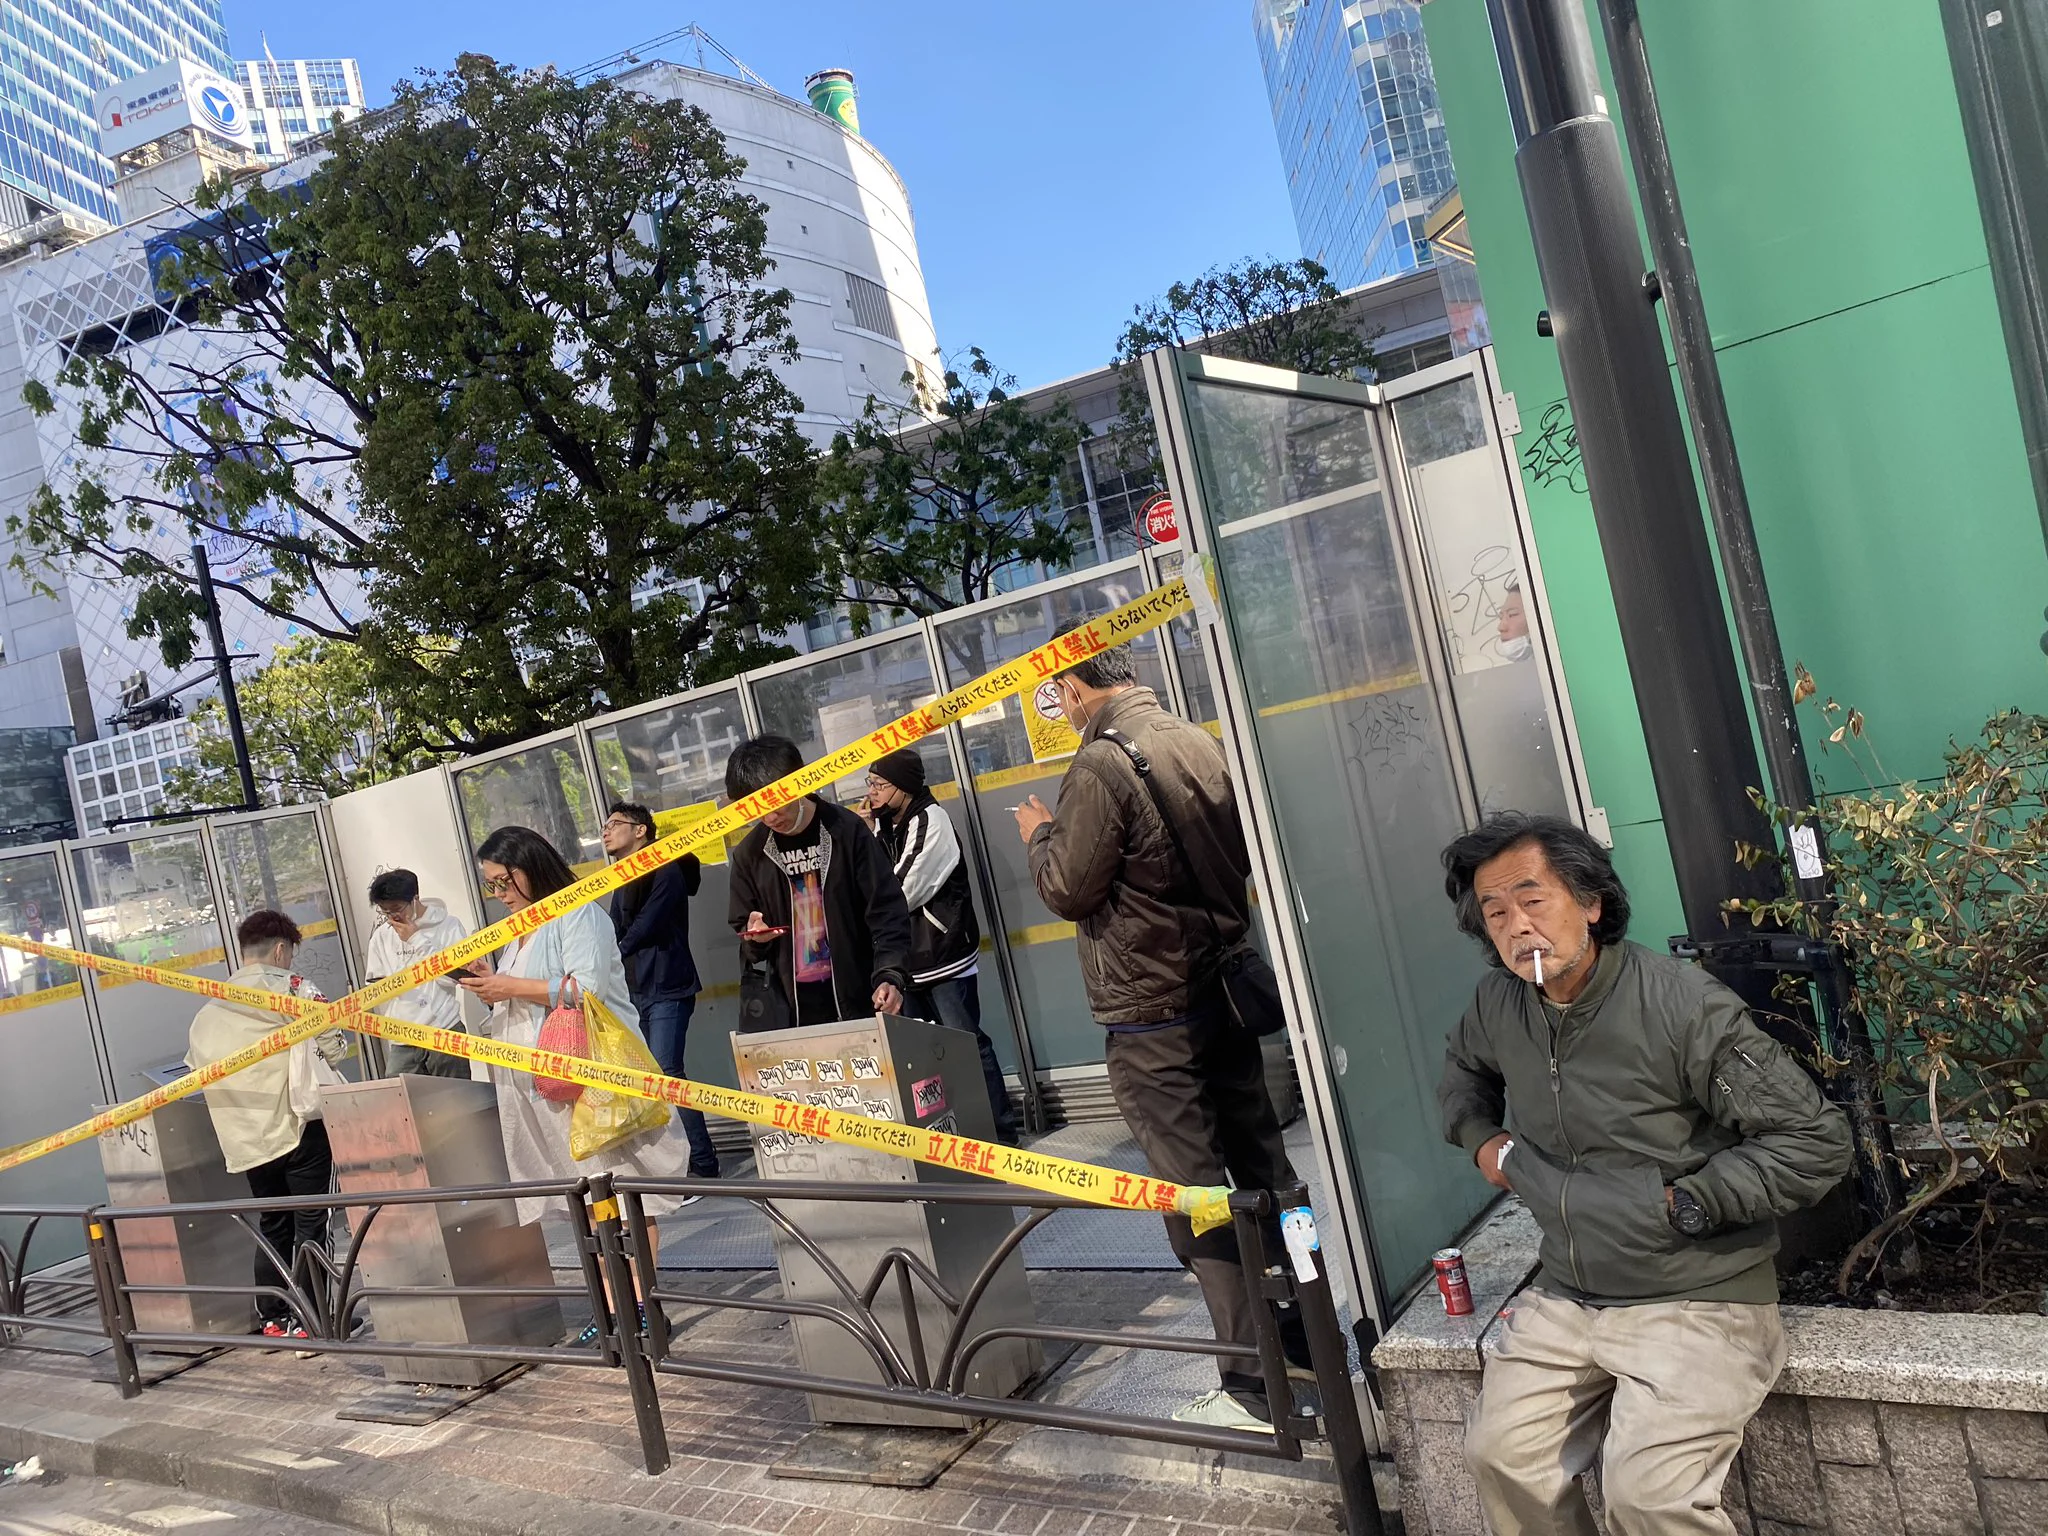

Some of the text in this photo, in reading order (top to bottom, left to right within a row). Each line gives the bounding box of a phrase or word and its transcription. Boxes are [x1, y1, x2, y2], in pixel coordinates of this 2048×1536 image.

[124, 93, 183, 124] TOKYU
[259, 1029, 289, 1056] 立入禁止
[328, 997, 362, 1024] 立入禁止
[363, 976, 407, 1004] 入らないでください
[411, 951, 453, 984] 立入禁止
[452, 929, 502, 961] 入らないでください
[506, 902, 556, 937] 立入禁止
[554, 876, 610, 911] 入らないでください
[613, 846, 671, 883] 立入禁止
[665, 816, 732, 854] 入らないでください
[735, 782, 798, 821] 立入禁止
[793, 747, 867, 790] 入らないでください
[871, 709, 943, 754] 立入禁止
[938, 669, 1022, 719] 入らないでください
[1029, 625, 1109, 678] 立入禁止
[1107, 582, 1191, 636] 入らないでくださ
[197, 978, 225, 999] 立入禁止
[270, 994, 301, 1019] 立入禁止
[384, 1021, 428, 1041] 入らないでください
[433, 1030, 470, 1056] 立入禁止
[473, 1041, 523, 1064] 入らないでください
[530, 1052, 573, 1080] 立入禁止
[576, 1064, 634, 1087] 入らないでください
[641, 1074, 692, 1108] 立入禁止
[696, 1089, 763, 1115] 入らないでください
[772, 1102, 831, 1137] 立入禁止
[836, 1118, 916, 1148] 入らないでください
[926, 1134, 995, 1174] 立入禁止
[1002, 1152, 1098, 1188] 入らないでください
[1110, 1174, 1176, 1211] 立入禁
